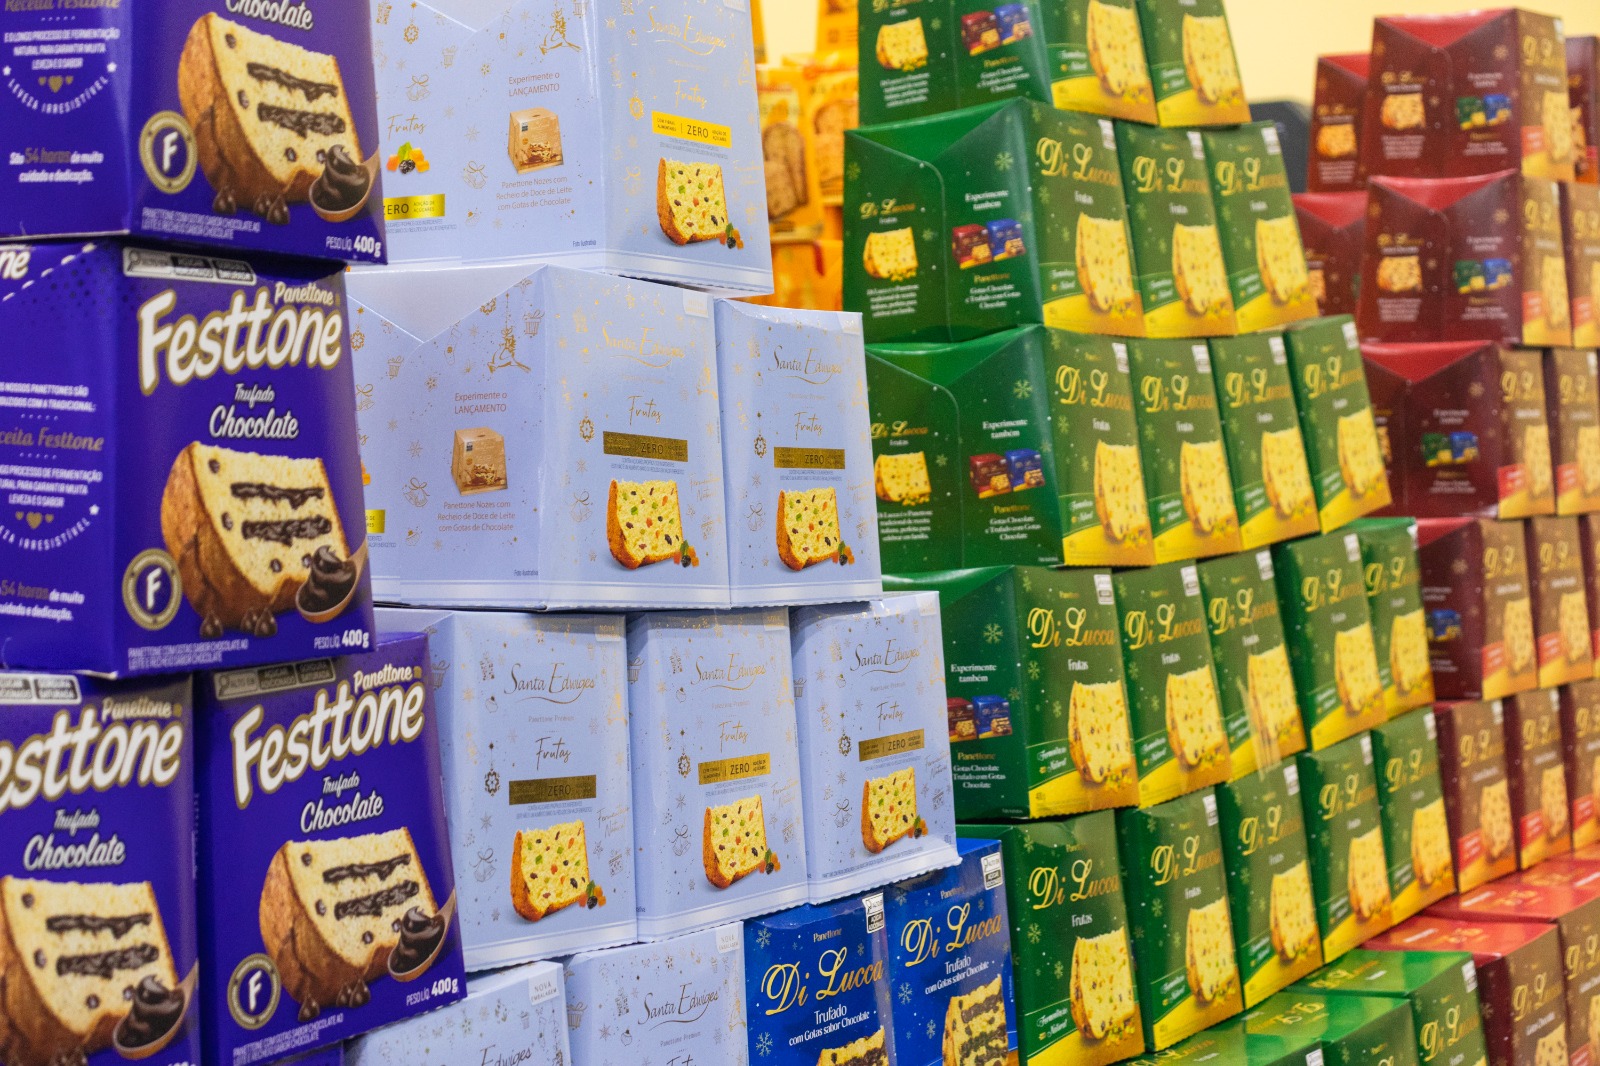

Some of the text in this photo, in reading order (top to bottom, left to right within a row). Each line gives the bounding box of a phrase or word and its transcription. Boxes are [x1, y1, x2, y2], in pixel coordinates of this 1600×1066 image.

[509, 74, 553, 86] Experimente
[509, 83, 560, 97] LANÇAMENTO
[387, 114, 427, 140] Frutas
[687, 124, 709, 139] ZERO
[1036, 137, 1068, 177] Di
[530, 188, 546, 197] Doce
[539, 197, 571, 207] Chocolate
[384, 203, 410, 216] ERO
[138, 287, 344, 395] Festtone
[1055, 365, 1087, 405] Di
[235, 383, 275, 409] Trufado
[455, 393, 498, 402] Experimente
[454, 403, 507, 415] LANÇAMENTO
[209, 404, 299, 439] Chocolate
[794, 411, 823, 440] Frutas
[982, 418, 1028, 431] Experimente
[991, 429, 1020, 439] também
[641, 442, 664, 455] ZERO
[804, 454, 824, 464] ZERO
[444, 501, 475, 510] Panettone
[477, 501, 496, 509] Nozes
[437, 513, 464, 521] Recheio
[473, 512, 489, 520] Doce
[489, 512, 498, 520] de
[453, 524, 471, 532] Gotas
[482, 523, 514, 531] Chocolate
[1209, 597, 1235, 635] Di
[1027, 607, 1116, 648] Di Lucca
[1125, 604, 1202, 650] Di Lucca
[850, 643, 882, 671] Santa
[1067, 659, 1089, 671] Frutas
[1161, 652, 1181, 665] Frutas
[504, 663, 595, 694] Santa Edwiges
[691, 656, 724, 685] Santa
[951, 663, 997, 674] Experimente
[959, 674, 988, 683] também
[354, 664, 413, 694] Panettone
[876, 701, 904, 731] Frutas
[231, 679, 425, 809] Festtone
[718, 720, 748, 753] Frutas
[888, 739, 906, 751] ZERO
[0, 705, 184, 814] sttone
[535, 737, 571, 771] Frutas
[957, 752, 996, 761] Panettone
[730, 762, 750, 775] ZERO
[953, 764, 999, 772] Gotas Chocolate
[322, 773, 360, 797] Trufado
[547, 785, 571, 797] ZERO
[962, 781, 991, 789] Chocolate
[54, 809, 100, 832] Trufado
[300, 790, 384, 834] Chocolate
[23, 833, 126, 871] Chocolate
[1151, 845, 1181, 887] Di
[1028, 859, 1120, 910] Di Lucca
[1184, 886, 1202, 900] Frutas
[1071, 914, 1093, 928] Frutas
[813, 927, 842, 943] Panettone
[901, 903, 1002, 967] Di Lucca
[944, 955, 972, 975] Trufado
[431, 977, 458, 997] 400g
[534, 982, 552, 993] NOVA
[761, 947, 884, 1016] Di Lucca
[925, 961, 989, 995] com Gotas sabor Chocolate
[638, 982, 719, 1025] Santa Edwiges
[814, 1004, 847, 1025] Trufado
[789, 1011, 870, 1046] com Gotas sabor Chocolate
